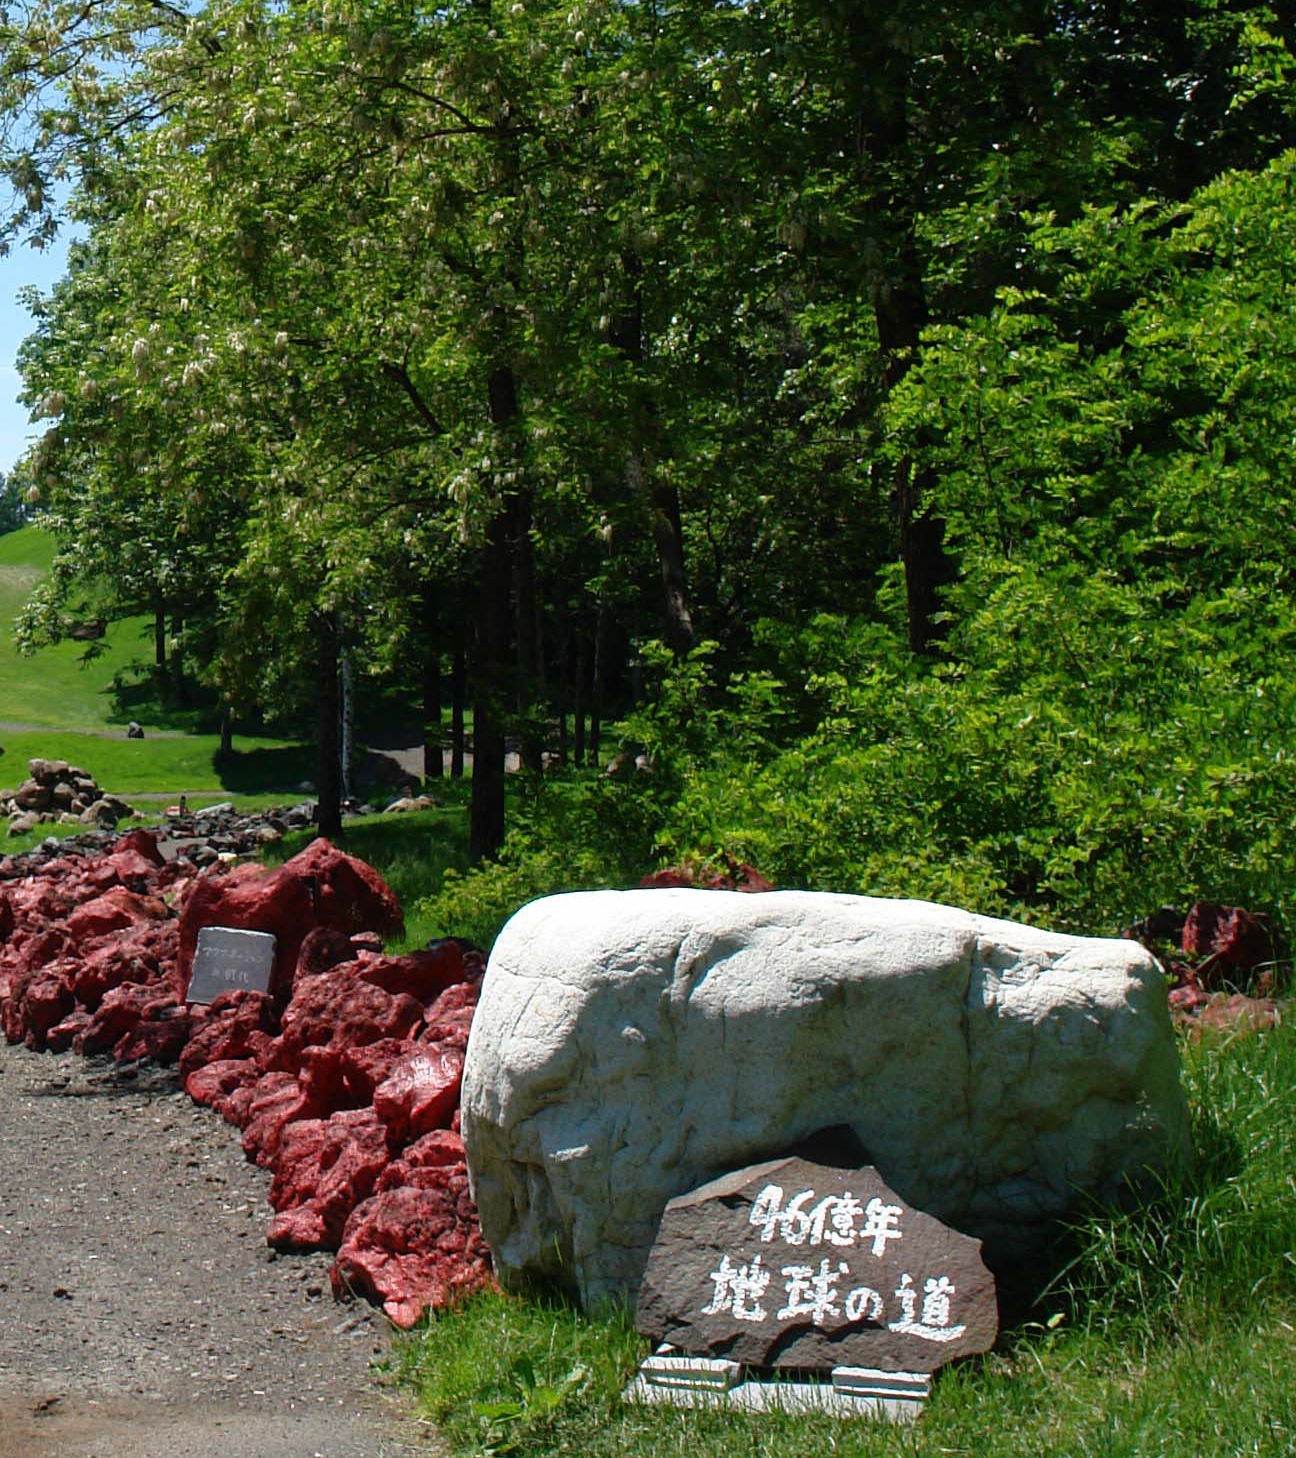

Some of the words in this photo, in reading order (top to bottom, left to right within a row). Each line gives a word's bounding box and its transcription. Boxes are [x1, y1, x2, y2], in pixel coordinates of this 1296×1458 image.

[749, 1184, 903, 1258] 46億年
[701, 1254, 967, 1342] 地球の道
